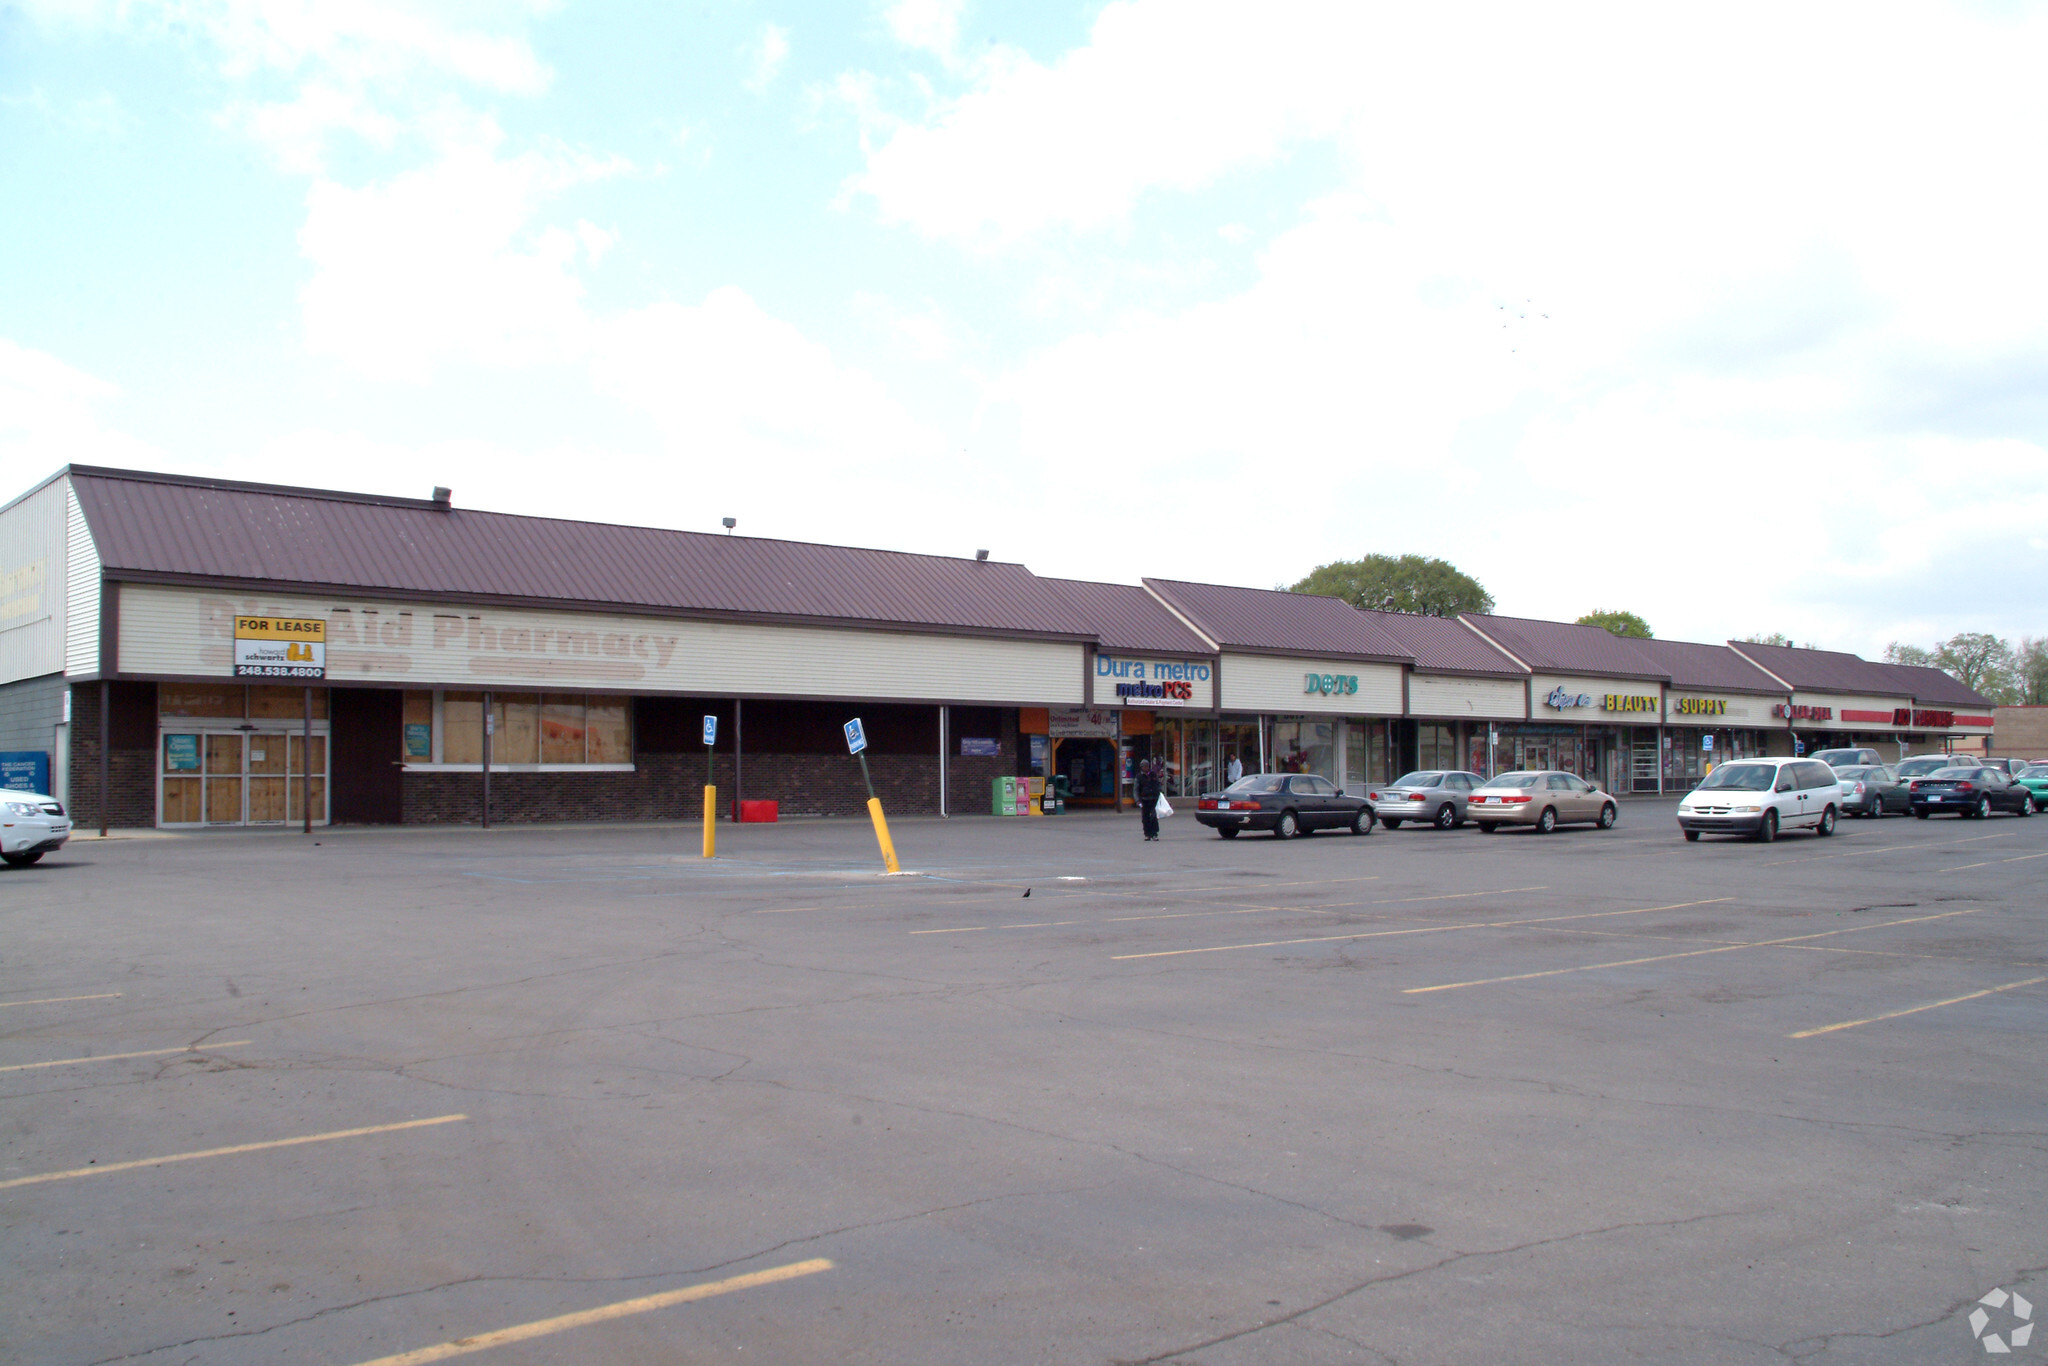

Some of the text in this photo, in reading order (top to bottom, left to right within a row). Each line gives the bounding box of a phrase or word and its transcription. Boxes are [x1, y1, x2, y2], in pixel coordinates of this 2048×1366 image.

[239, 619, 321, 633] FOR LEASE
[432, 614, 680, 670] Pharmacy
[245, 653, 285, 662] schwartz
[1097, 654, 1210, 681] Dura metro
[239, 665, 322, 677] 248.538.4800
[1116, 680, 1192, 700] metroPCS
[1303, 673, 1359, 696] DOTS
[1603, 693, 1659, 713] BEAUTY
[1676, 698, 1728, 716] SUPPLY
